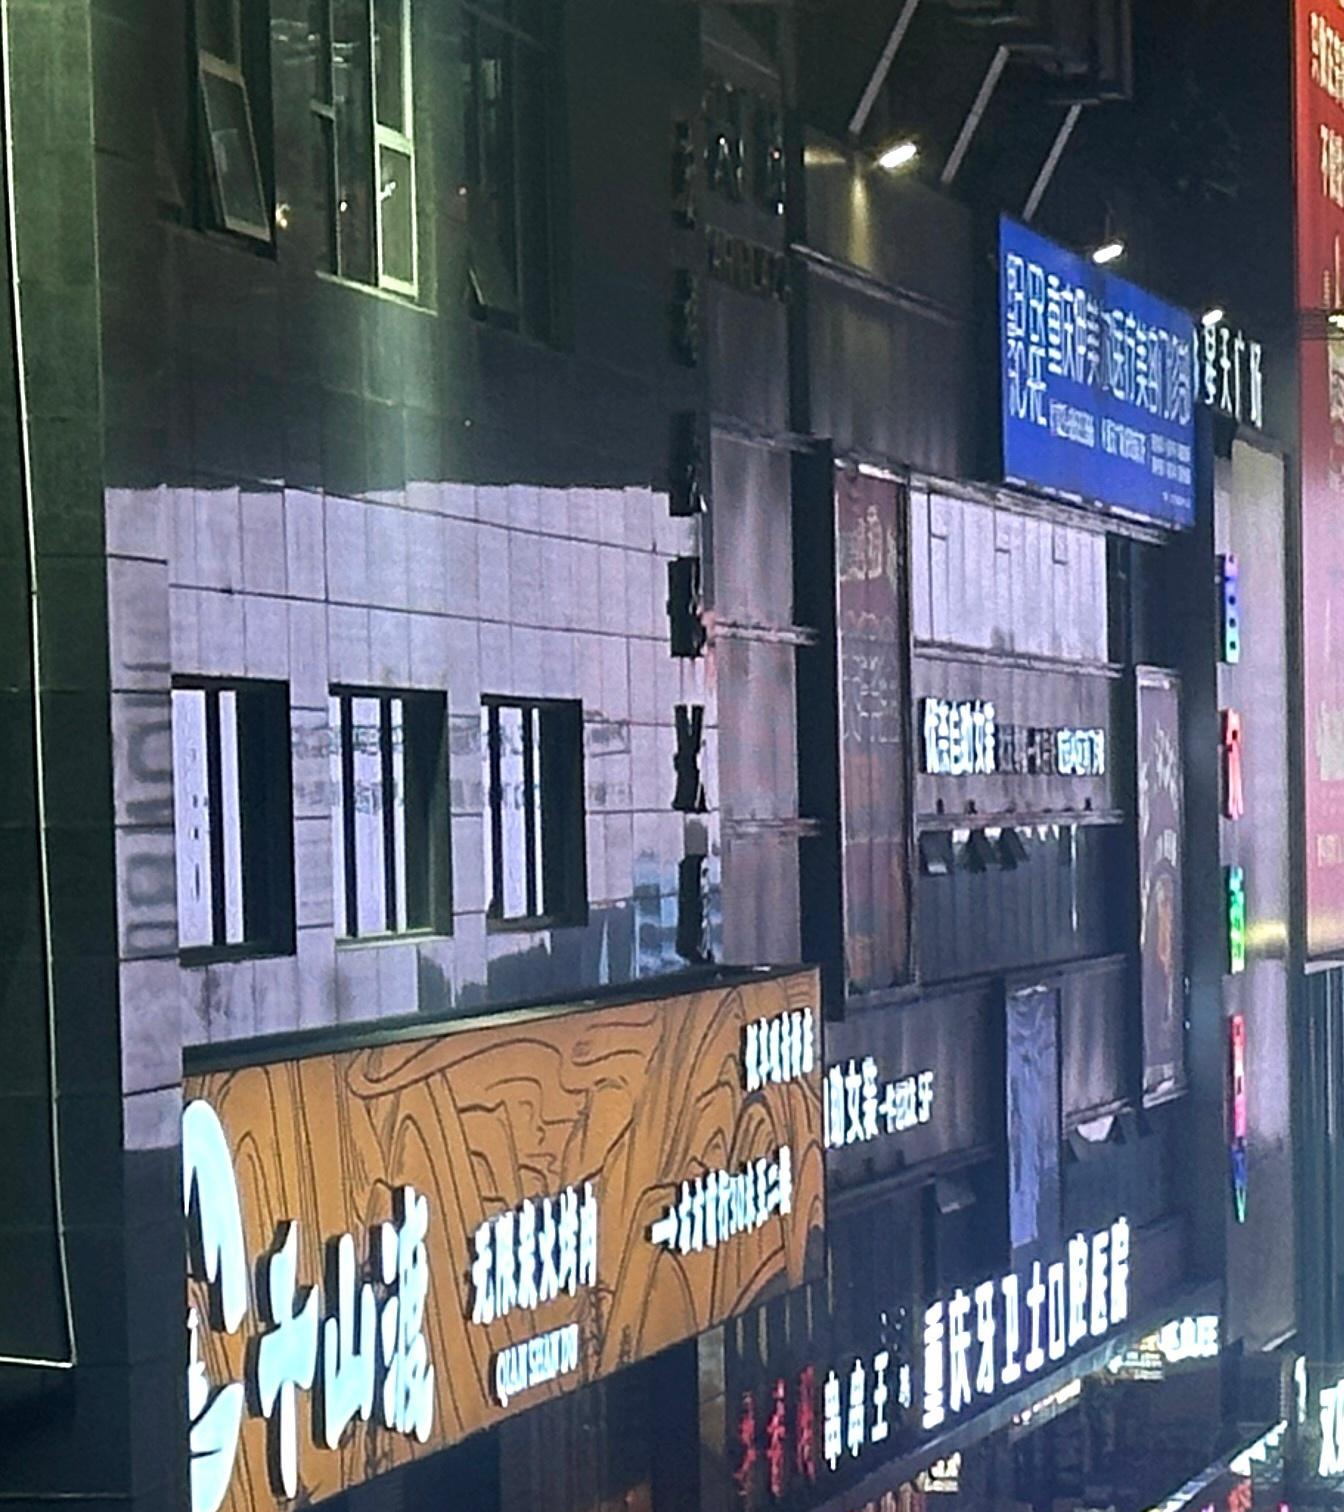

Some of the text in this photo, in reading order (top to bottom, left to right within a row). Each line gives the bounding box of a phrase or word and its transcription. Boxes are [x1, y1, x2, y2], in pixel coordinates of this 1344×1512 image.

[922, 1216, 1130, 1430] 重庆牙卫士口腔医院
